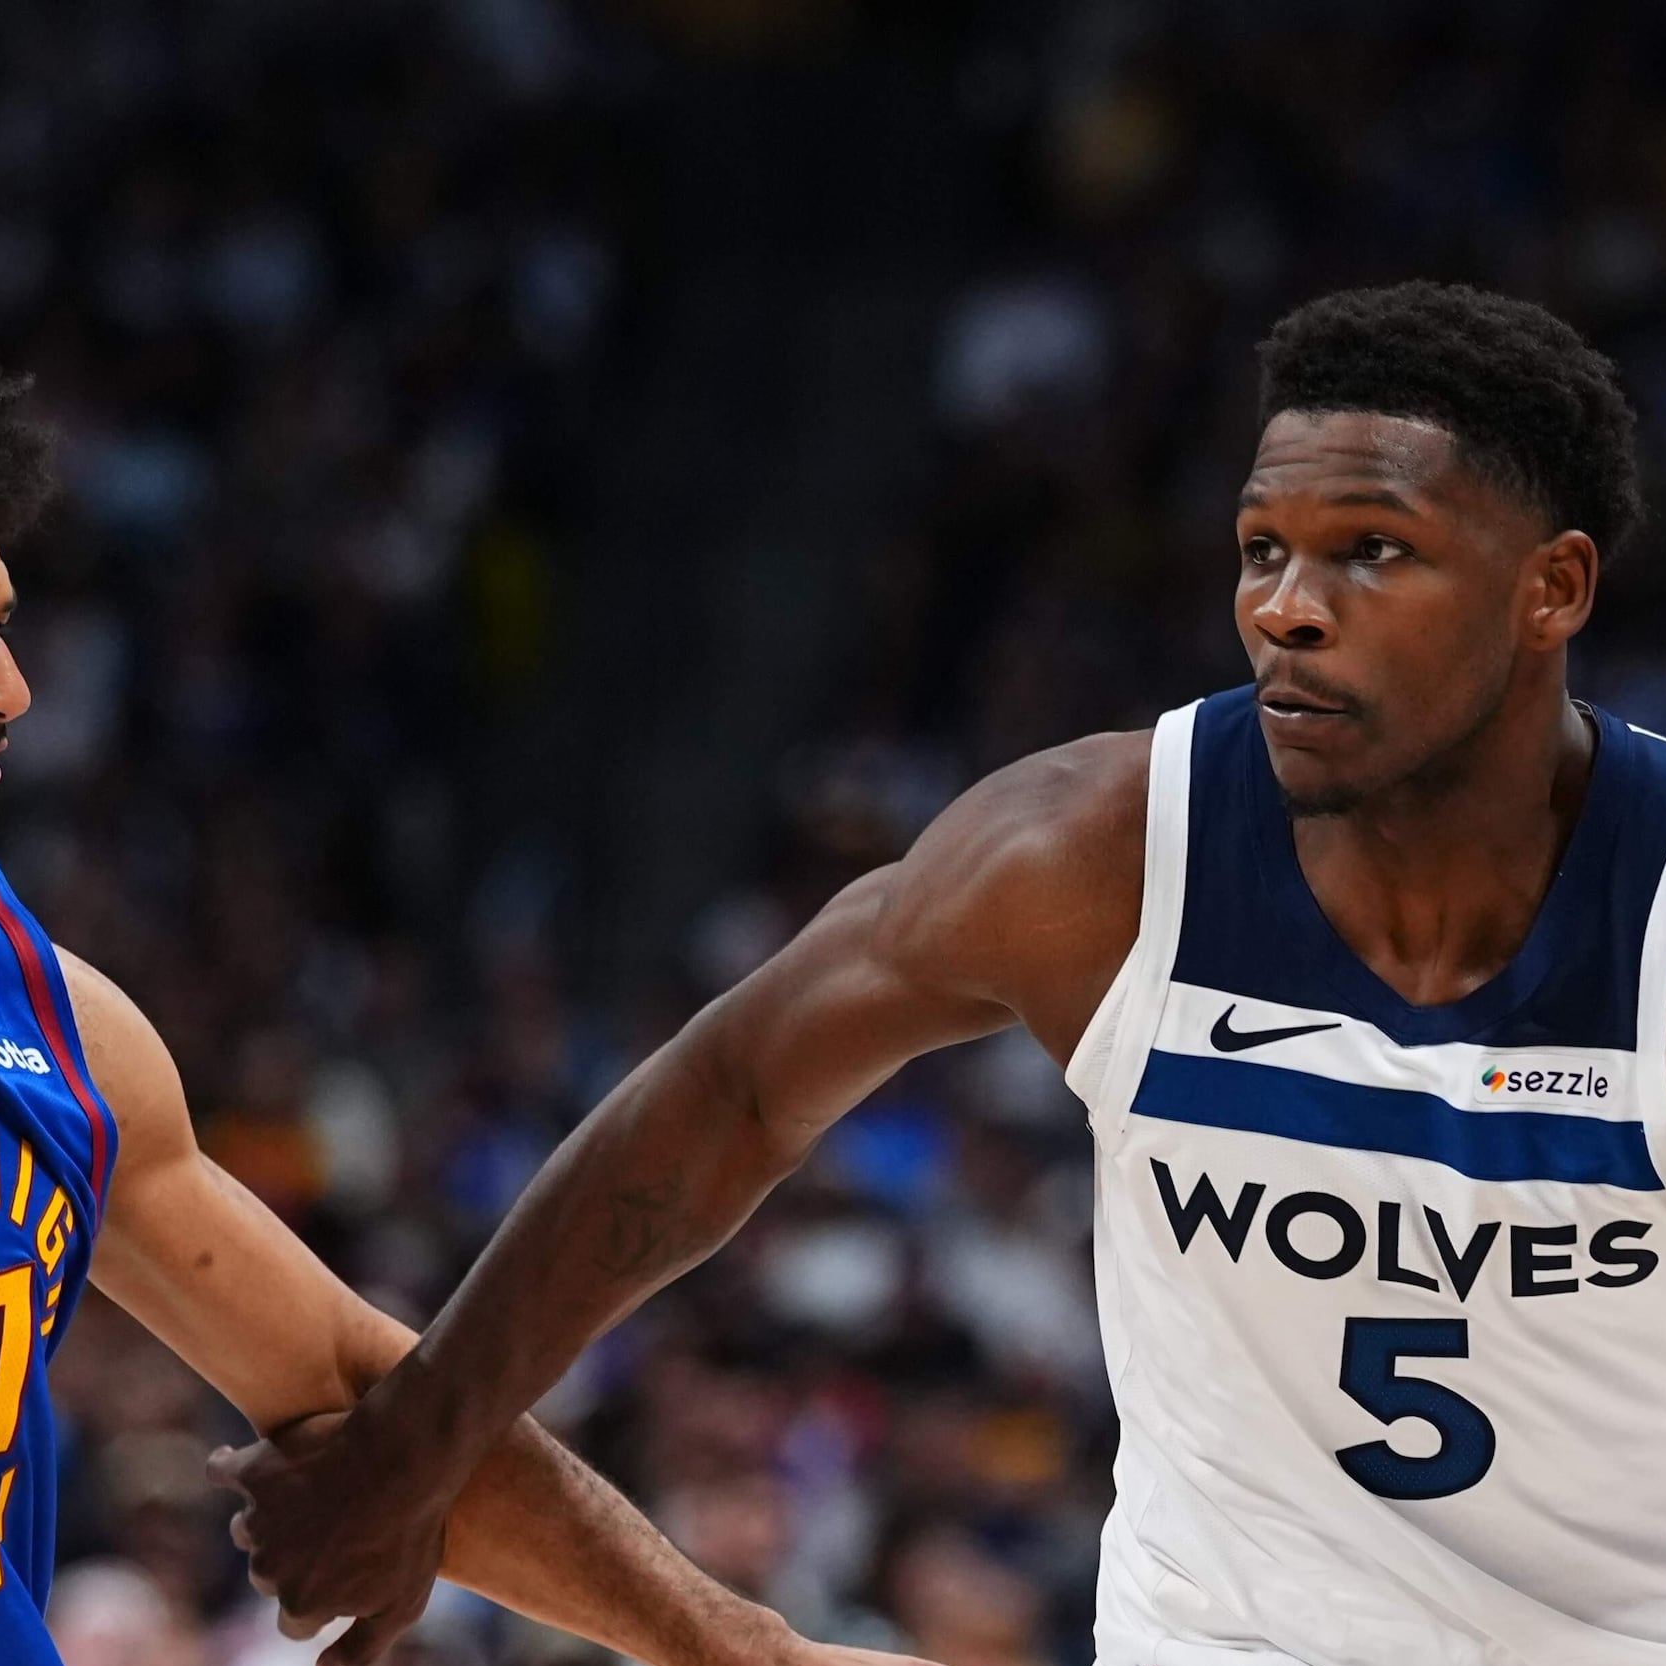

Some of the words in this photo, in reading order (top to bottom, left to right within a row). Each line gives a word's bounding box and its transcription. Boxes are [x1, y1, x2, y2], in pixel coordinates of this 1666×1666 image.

[1506, 1066, 1609, 1099] sezzle
[1150, 1157, 1660, 1302] WOLVES
[1335, 1316, 1497, 1500] 5
